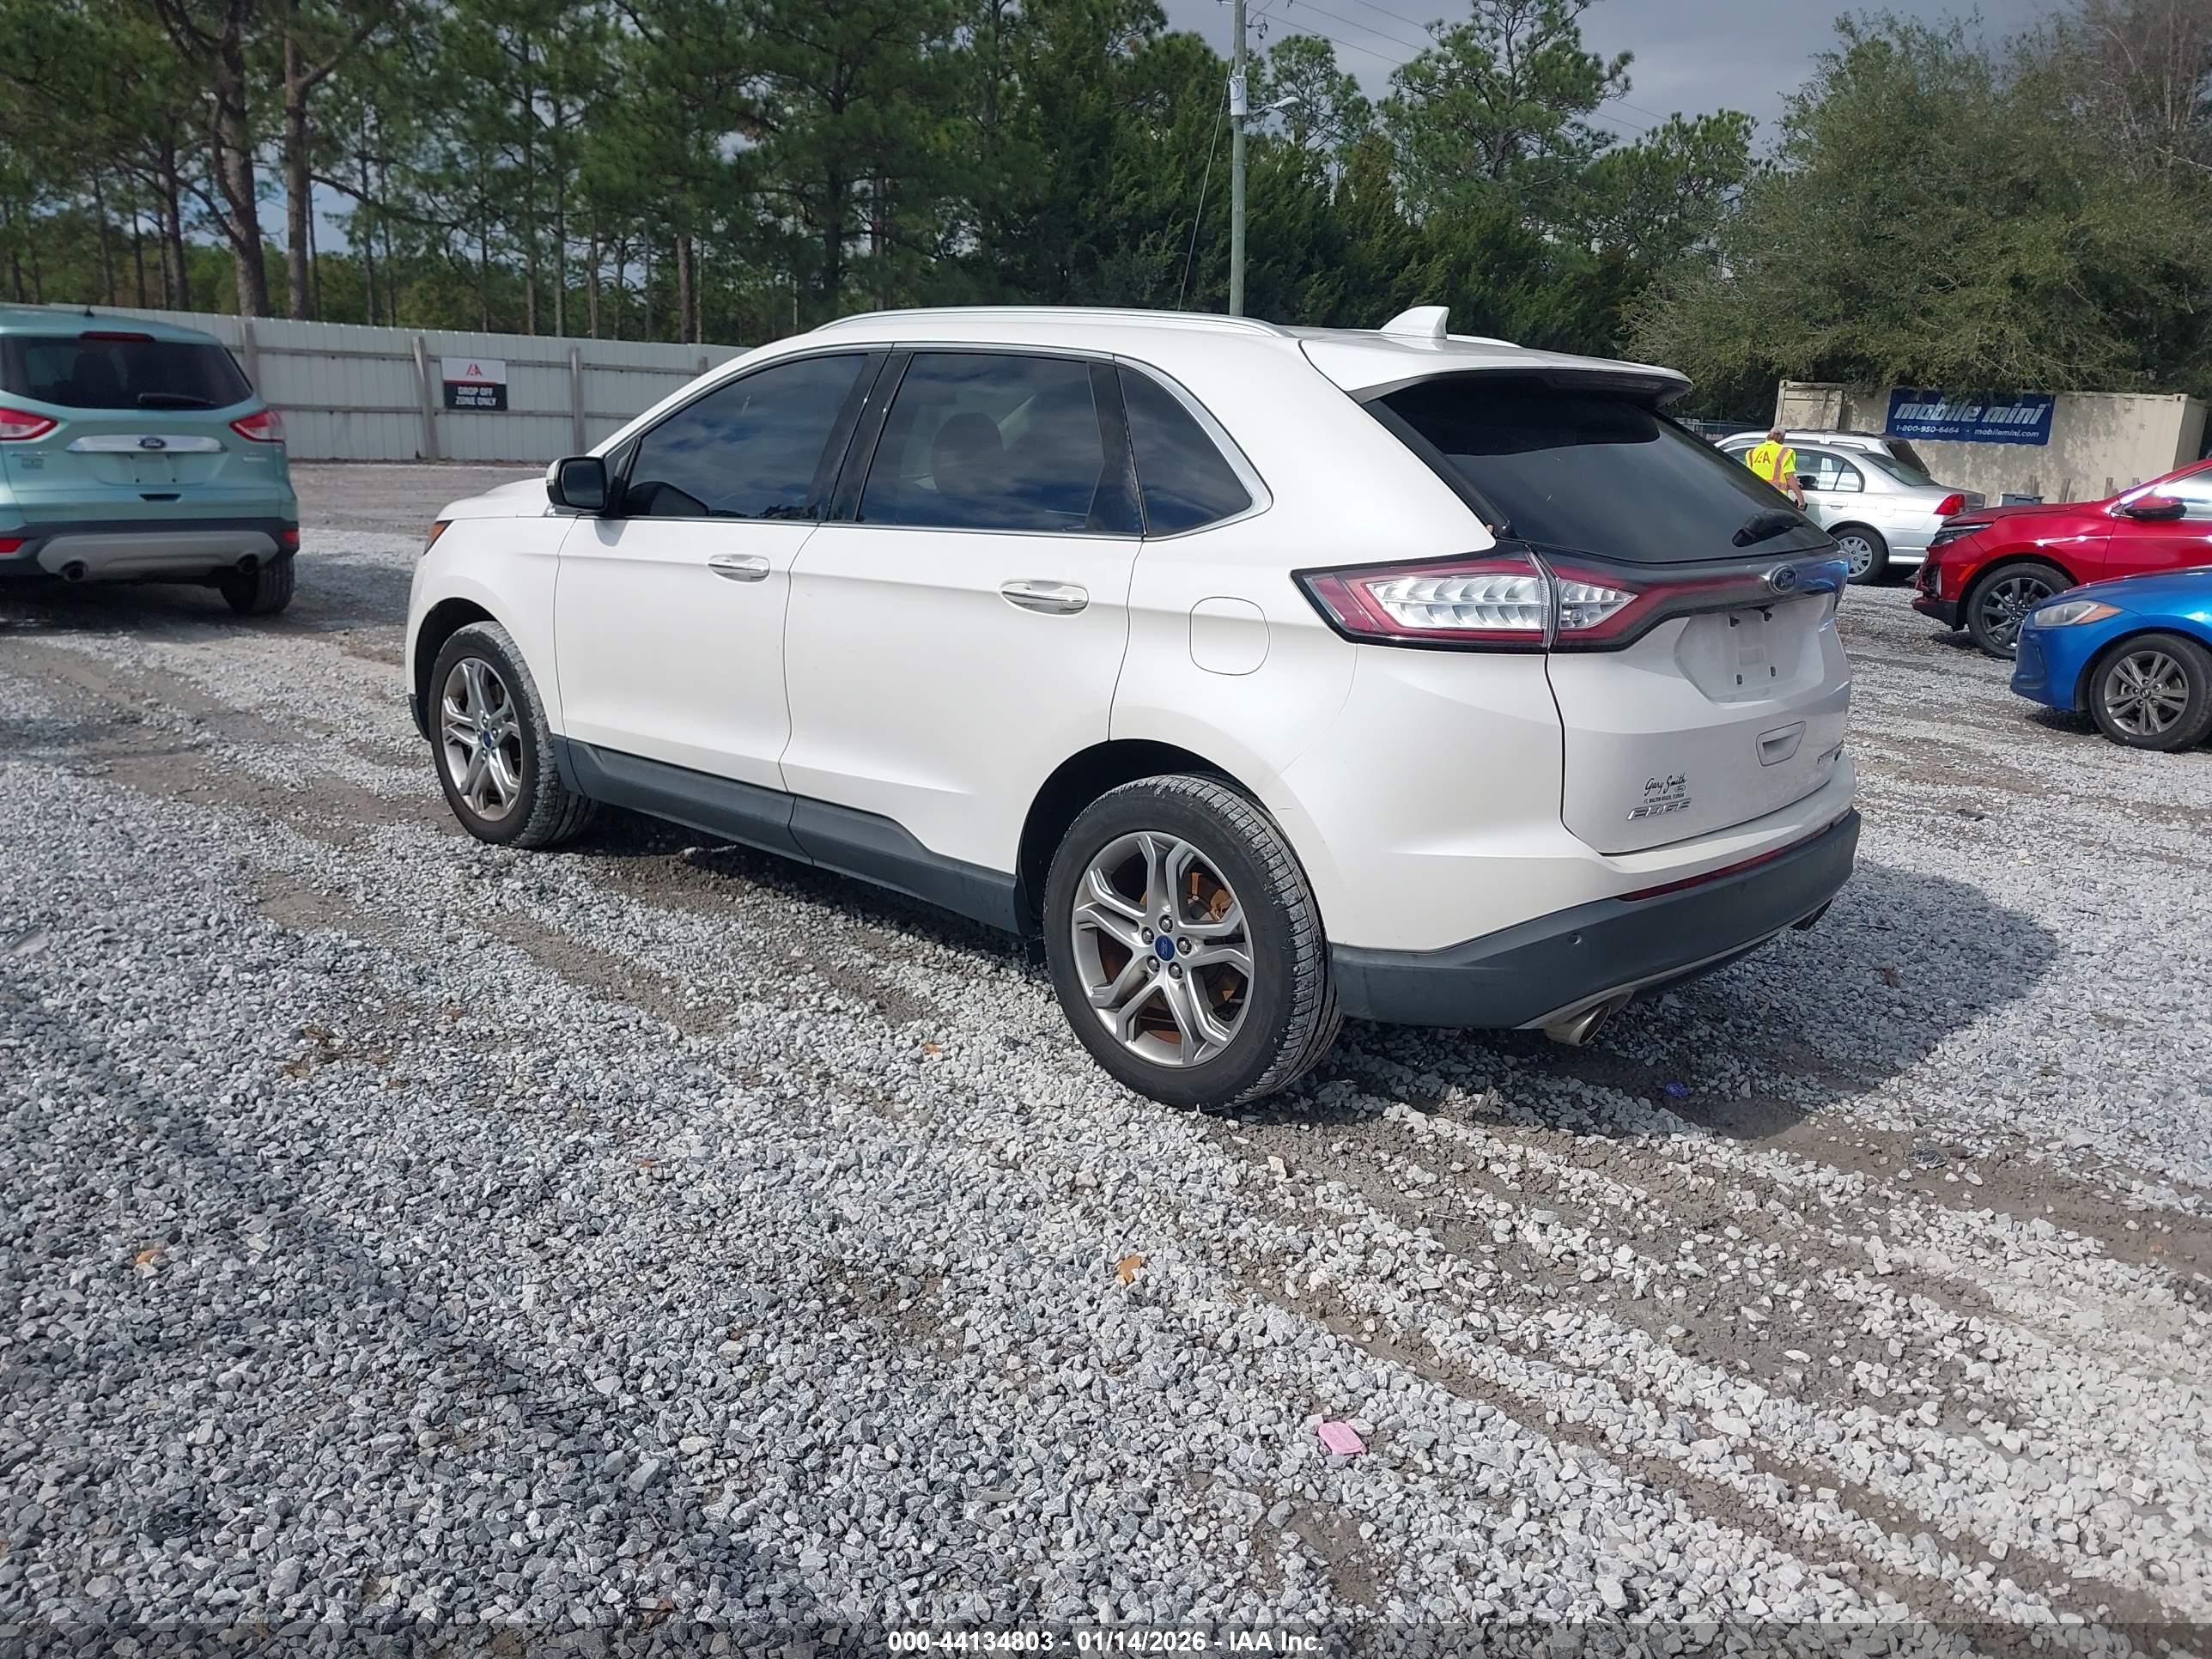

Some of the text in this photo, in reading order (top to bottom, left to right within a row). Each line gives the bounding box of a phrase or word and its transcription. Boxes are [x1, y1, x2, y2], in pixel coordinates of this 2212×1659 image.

[458, 386, 494, 396] DROP OFF
[455, 396, 497, 406] ZONE ONLY
[1893, 398, 2046, 424] mobile mini
[1895, 424, 2039, 438] 1-800-950-6464 mobilemini.com
[1644, 772, 1688, 796] Gary Smith
[1627, 799, 1692, 820] EDGE
